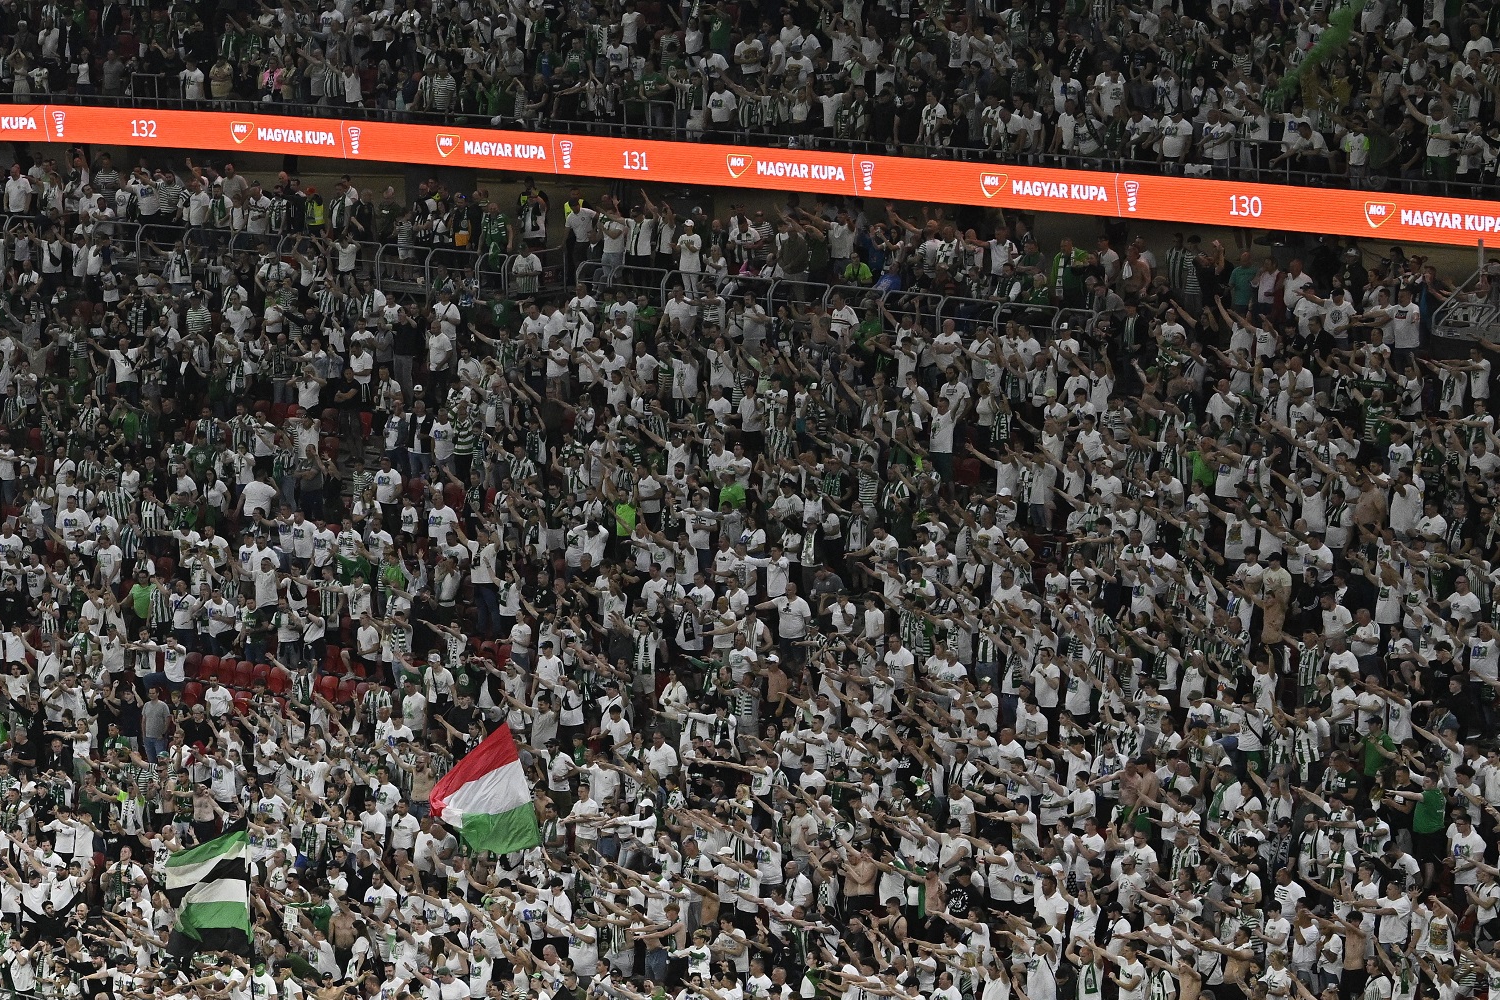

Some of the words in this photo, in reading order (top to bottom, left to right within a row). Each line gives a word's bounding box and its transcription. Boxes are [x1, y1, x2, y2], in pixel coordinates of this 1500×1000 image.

[0, 116, 37, 130] KUPA
[130, 119, 157, 138] 132
[257, 127, 304, 144] MAGYAR
[305, 130, 336, 146] KUPA
[463, 140, 513, 158] MAGYAR
[514, 143, 546, 160] KUPA
[622, 150, 649, 171] 131
[756, 160, 809, 179] MAGYAR
[811, 164, 846, 182] KUPA
[1012, 179, 1068, 199] MAGYAR
[1070, 183, 1108, 202] KUPA
[1229, 194, 1262, 218] 130
[1400, 209, 1463, 230] MAGYAR
